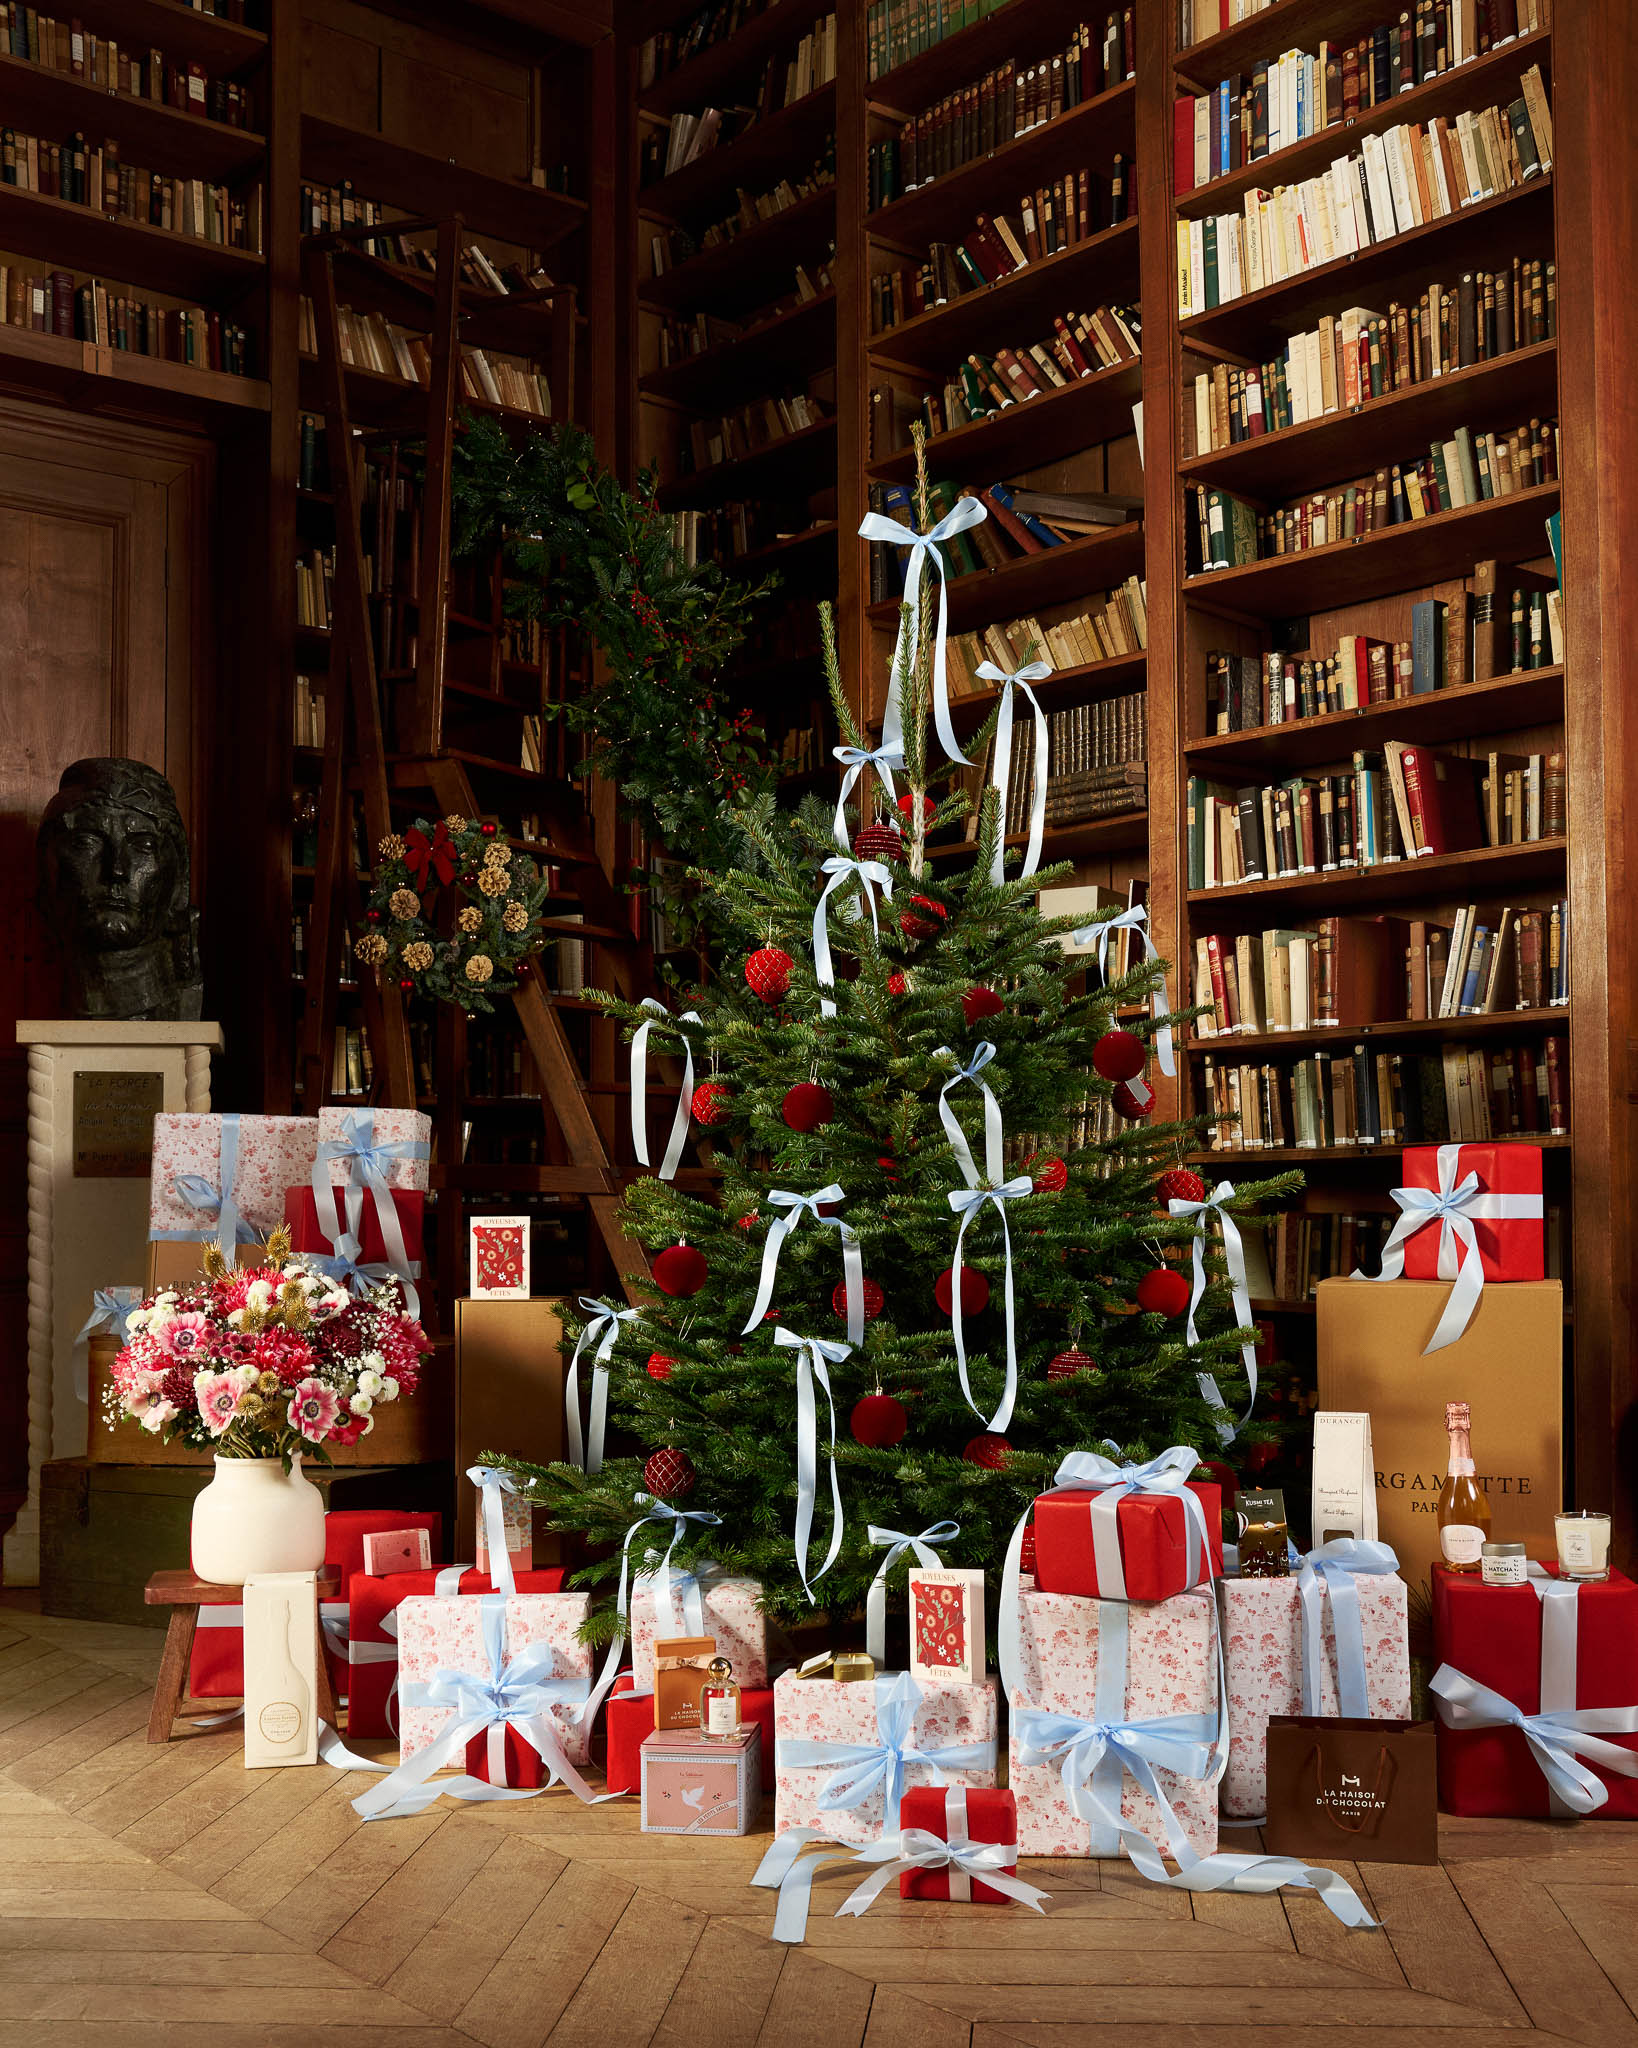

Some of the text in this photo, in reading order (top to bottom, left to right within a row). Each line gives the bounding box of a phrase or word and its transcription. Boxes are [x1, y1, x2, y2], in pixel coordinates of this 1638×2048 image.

[1345, 118, 1354, 127] 10
[1374, 1471, 1532, 1495] RGAMTTE
[1245, 1498, 1274, 1507] KUSMI TEA
[1411, 1501, 1438, 1513] PAR
[921, 1572, 956, 1582] JOYEUSES
[1324, 1789, 1336, 1797] LA
[1332, 1798, 1386, 1809] CHOCOLAT
